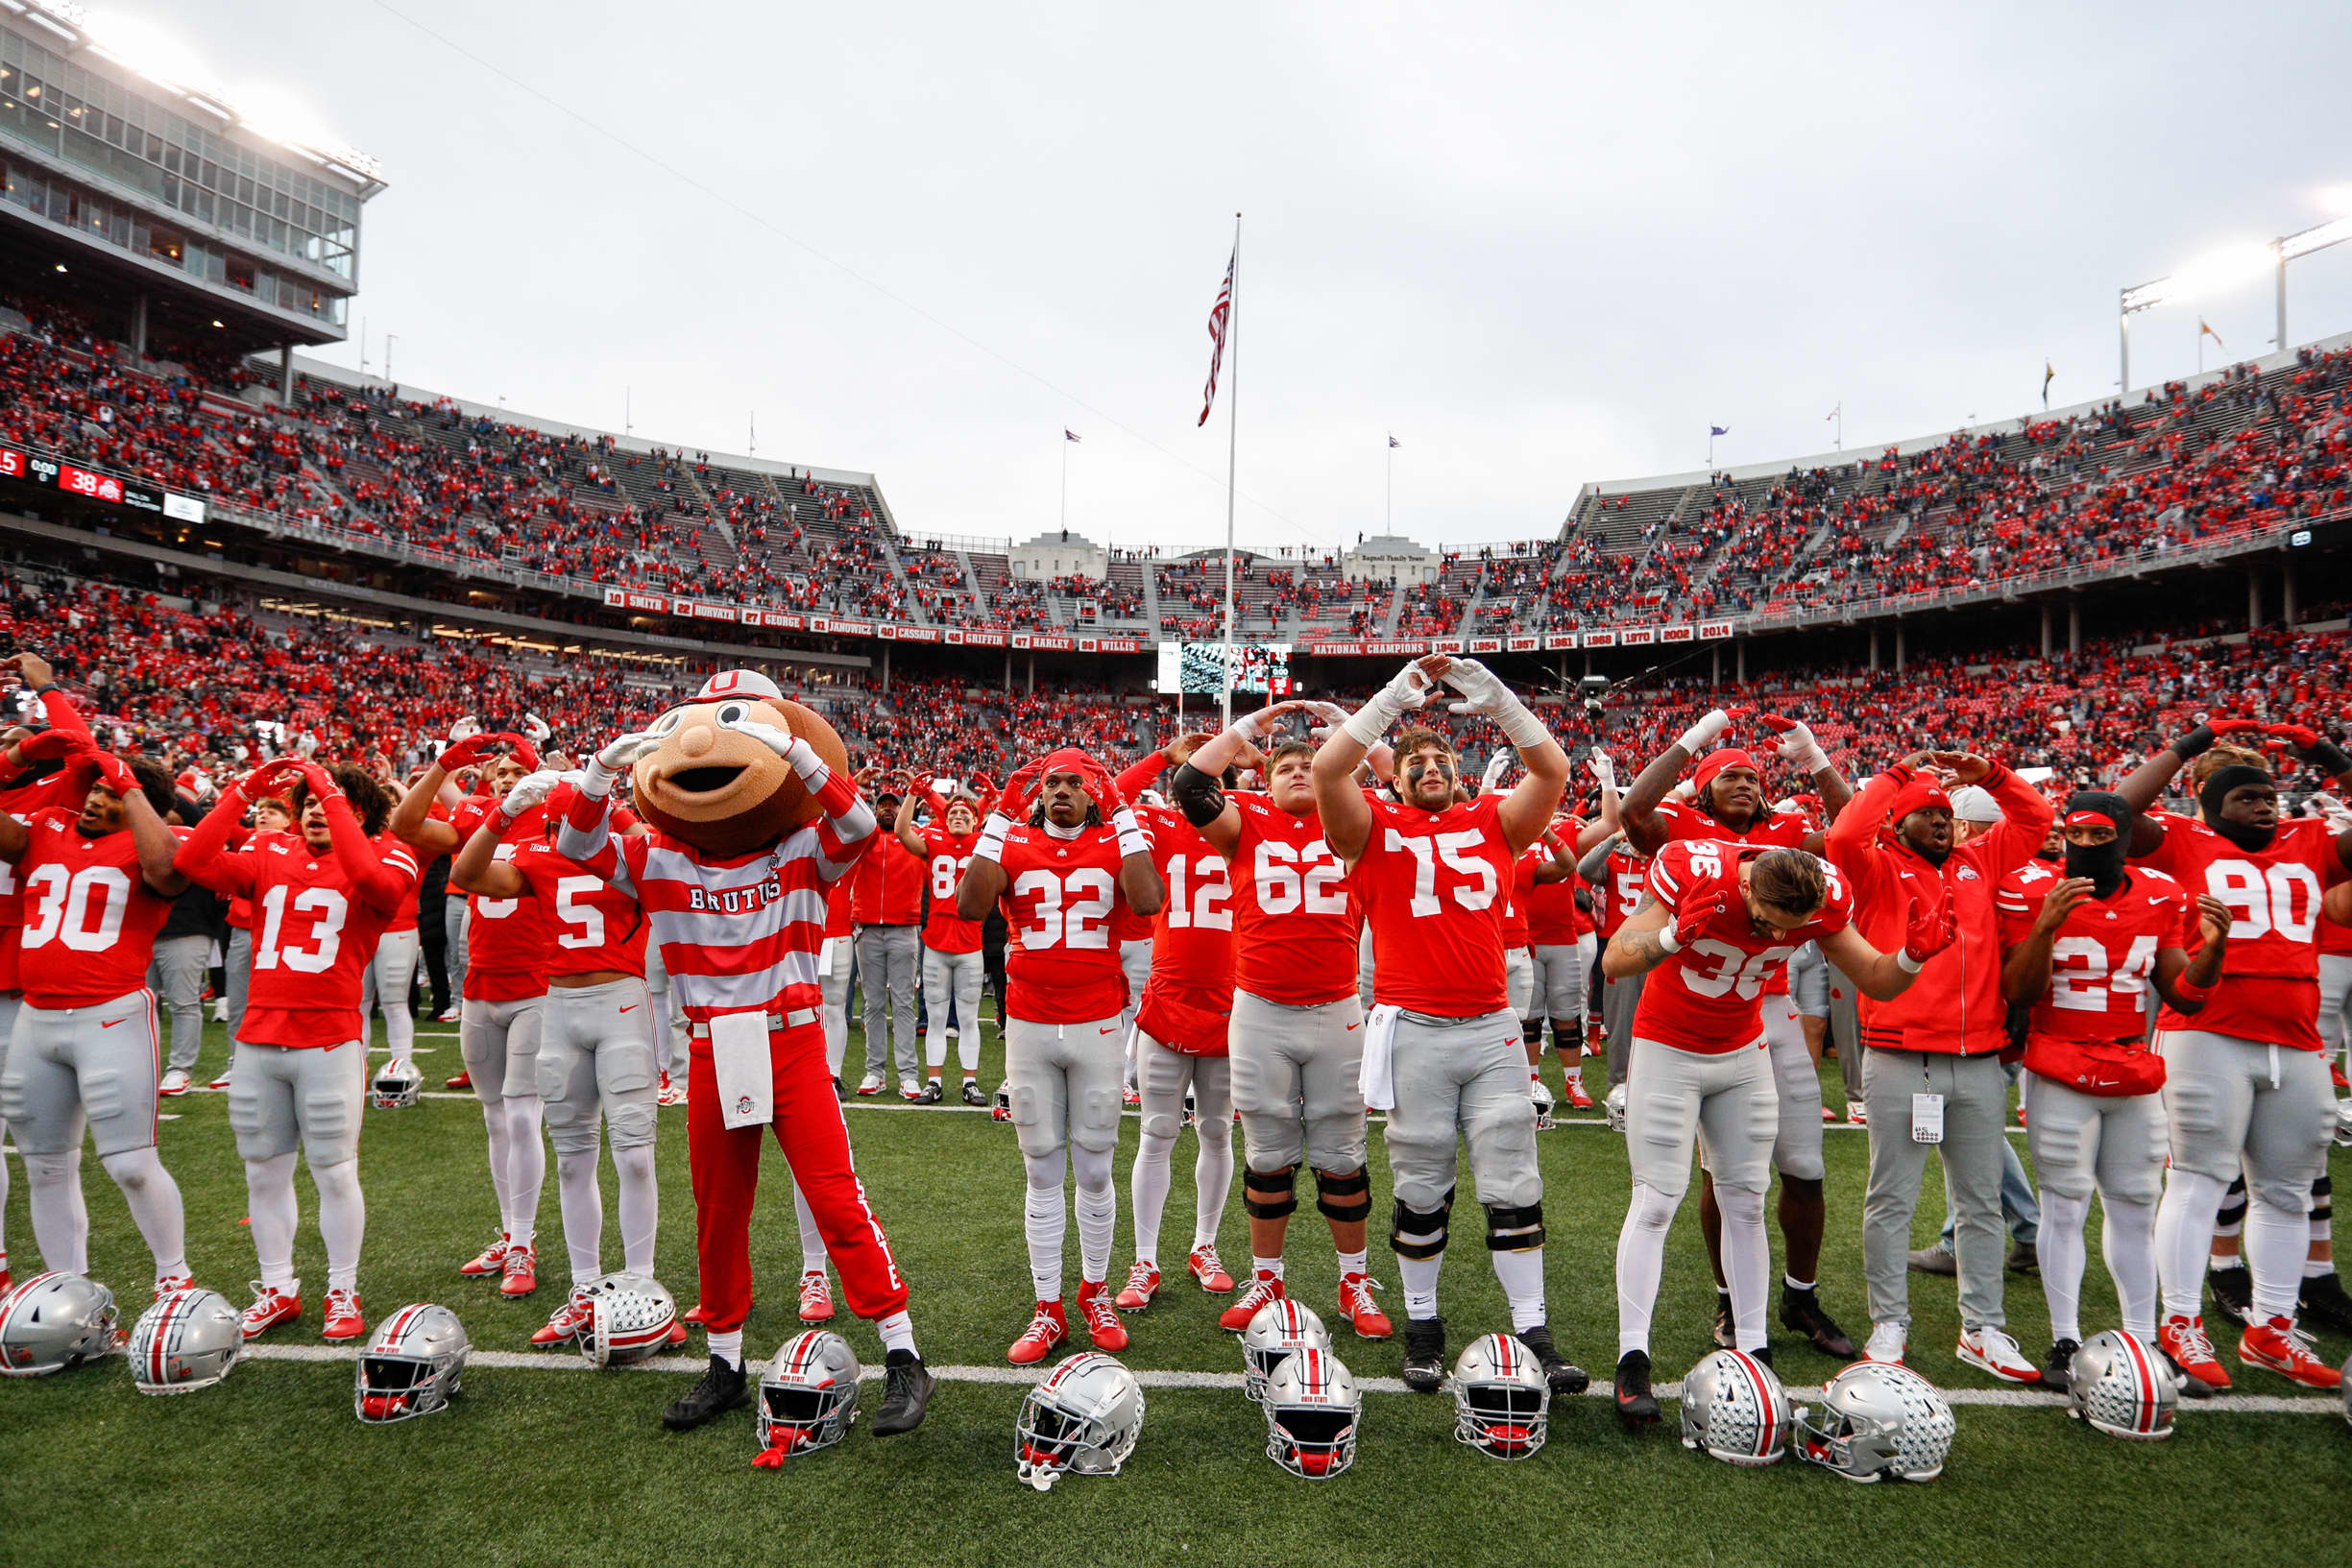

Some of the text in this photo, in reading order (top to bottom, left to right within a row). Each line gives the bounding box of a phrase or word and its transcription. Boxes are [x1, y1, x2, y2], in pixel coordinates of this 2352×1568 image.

[0, 451, 16, 470] 5
[70, 470, 97, 493] 38
[609, 593, 662, 611] 10 SMITH
[677, 603, 735, 621] 22 HORVATH
[745, 612, 800, 628] 27 GEORGE
[829, 621, 872, 636] JANOWICZ
[880, 627, 937, 641] 40 CASSADY
[1663, 628, 1690, 640] 2002
[1702, 626, 1729, 637] 2014
[966, 634, 1004, 646] GRIFFIN
[1015, 636, 1069, 649] 47 HARLEY
[1101, 640, 1135, 651] WILLIS
[1511, 640, 1535, 650] 1957
[1550, 638, 1573, 648] 1961
[1587, 634, 1612, 645] 1968
[1625, 632, 1650, 643] 1970
[1314, 643, 1424, 654] NATIONAL CHAMPIONS
[1436, 642, 1460, 652] 1942
[1473, 641, 1497, 651] 1954
[1254, 839, 1347, 915] 62
[1384, 827, 1497, 917] 75
[690, 872, 782, 912] BRUTUS
[1166, 854, 1233, 931] 12
[21, 863, 131, 952] 30
[2205, 858, 2323, 943] 90
[556, 875, 605, 949] 5
[1014, 868, 1114, 950] 32
[255, 884, 348, 974] 13
[2051, 935, 2158, 1013] 24
